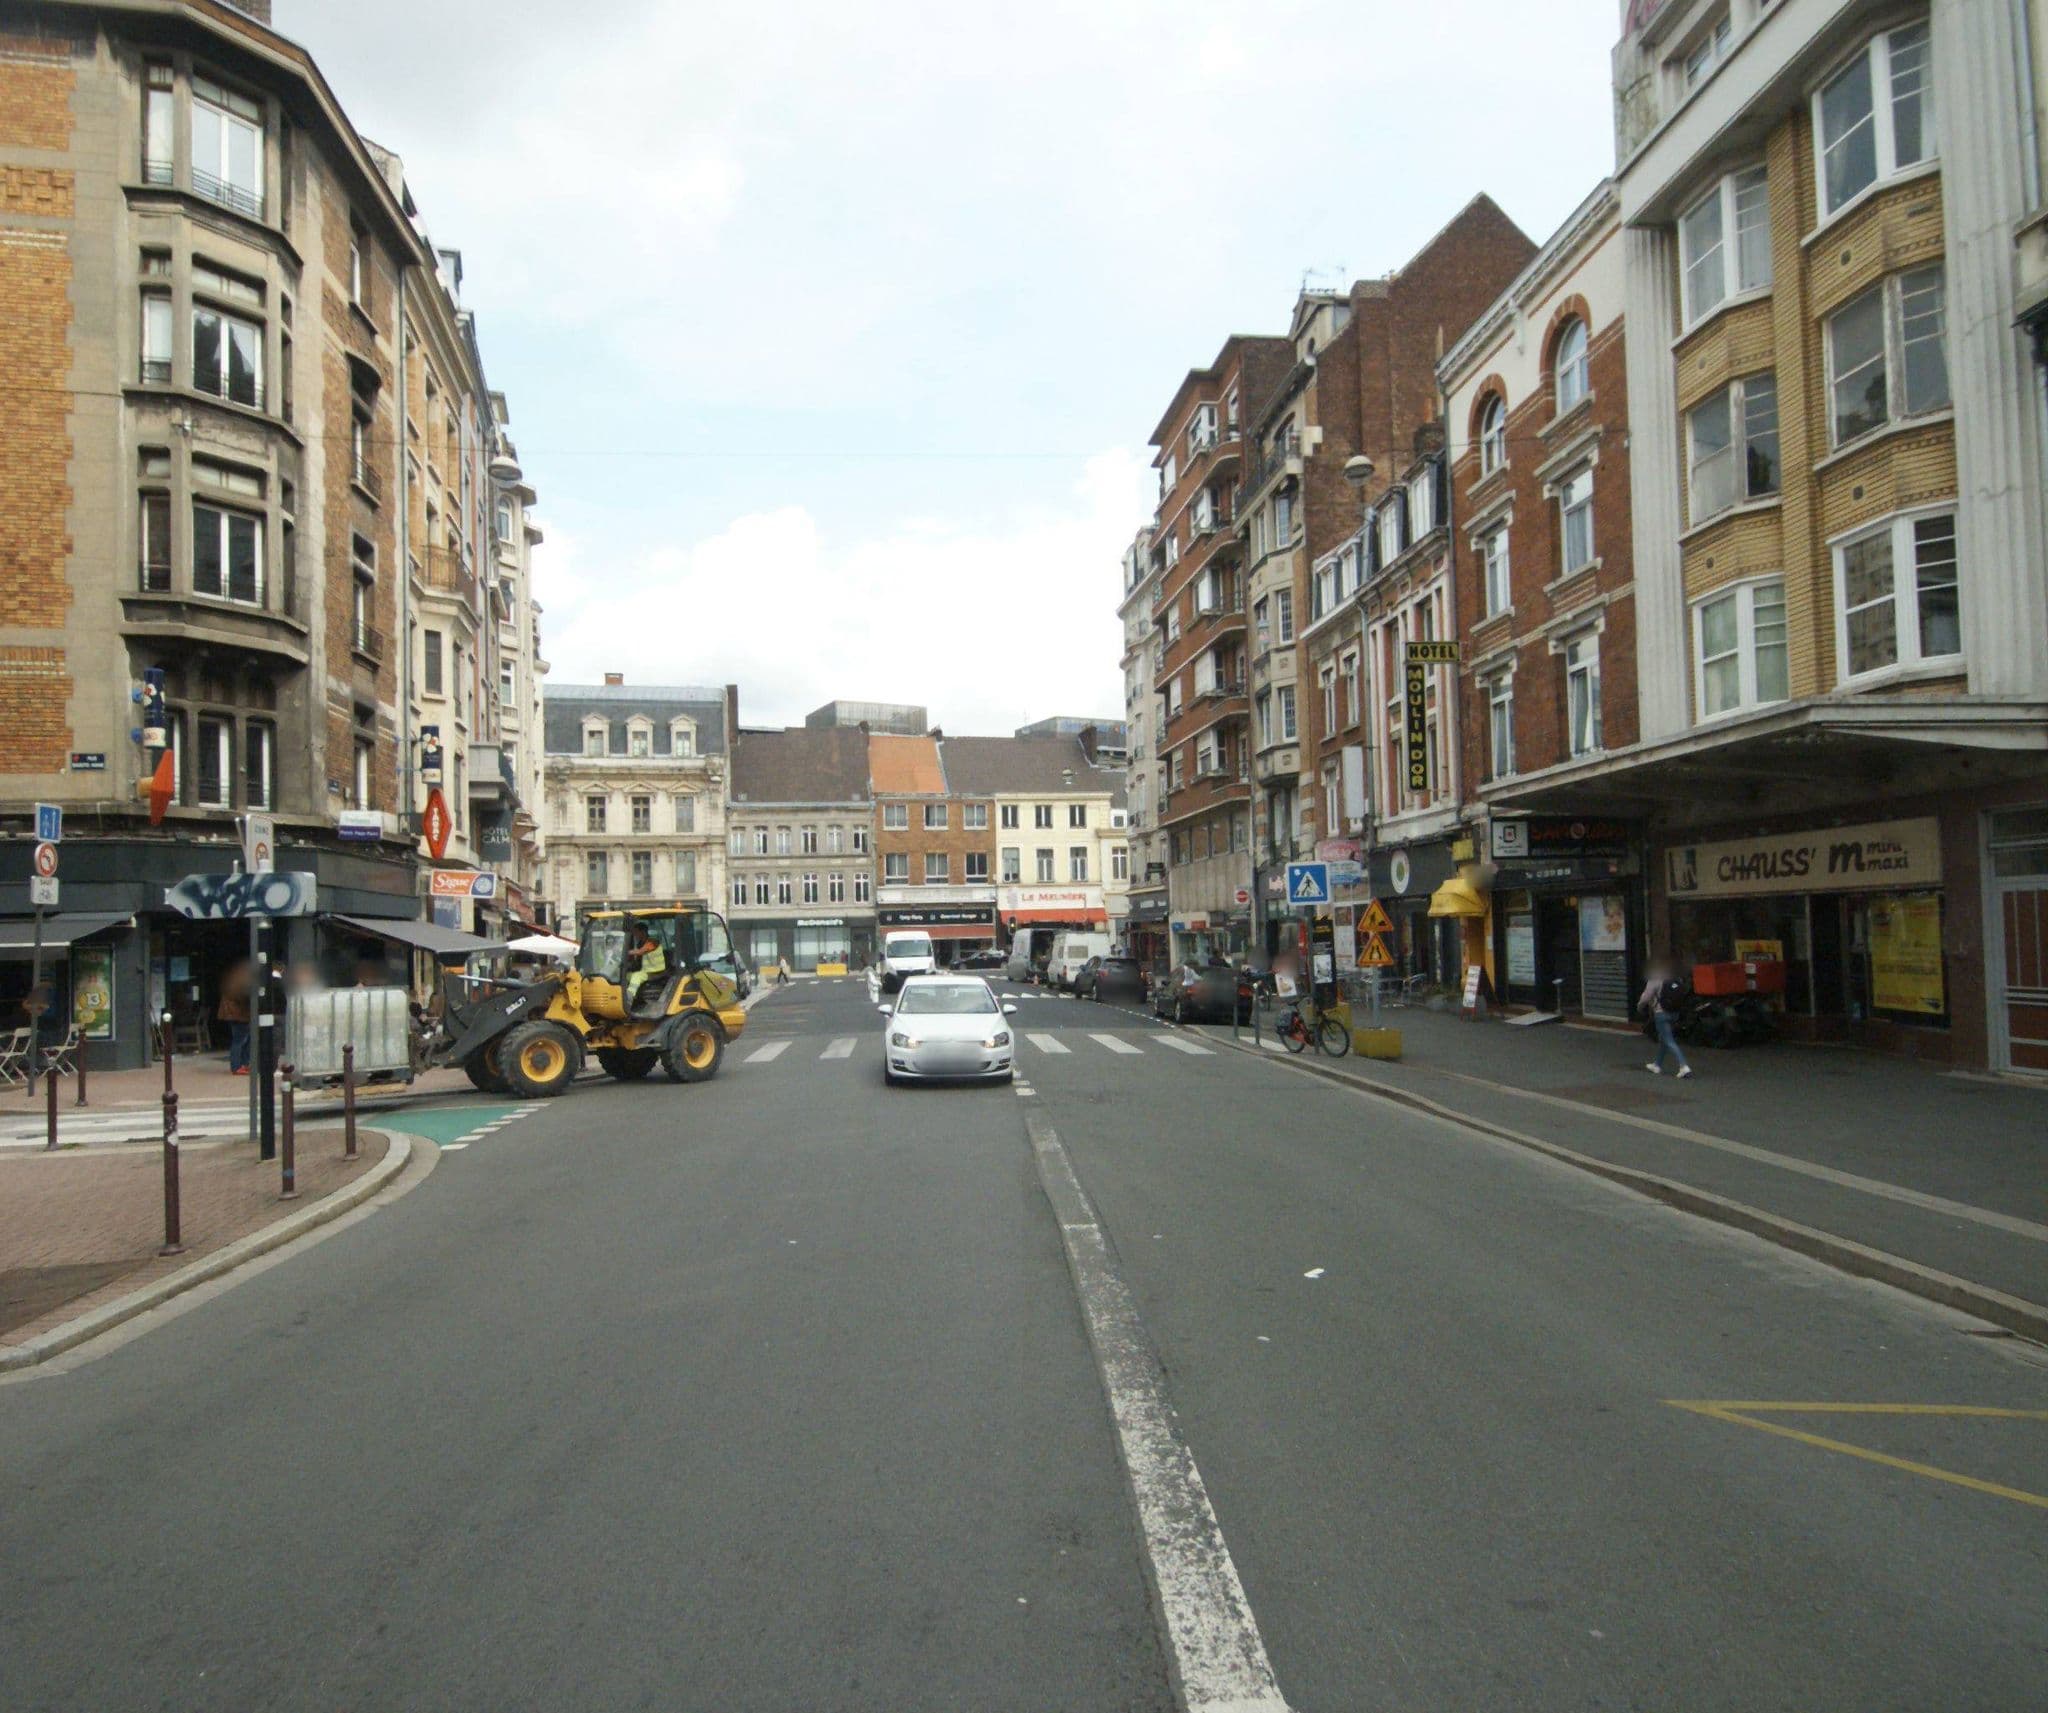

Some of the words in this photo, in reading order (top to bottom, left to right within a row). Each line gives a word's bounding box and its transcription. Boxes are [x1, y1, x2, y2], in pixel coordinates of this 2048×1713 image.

[1409, 645, 1455, 658] HOTEL
[1408, 669, 1424, 743] MOULIN
[1717, 847, 1816, 882] CHAUSS'
